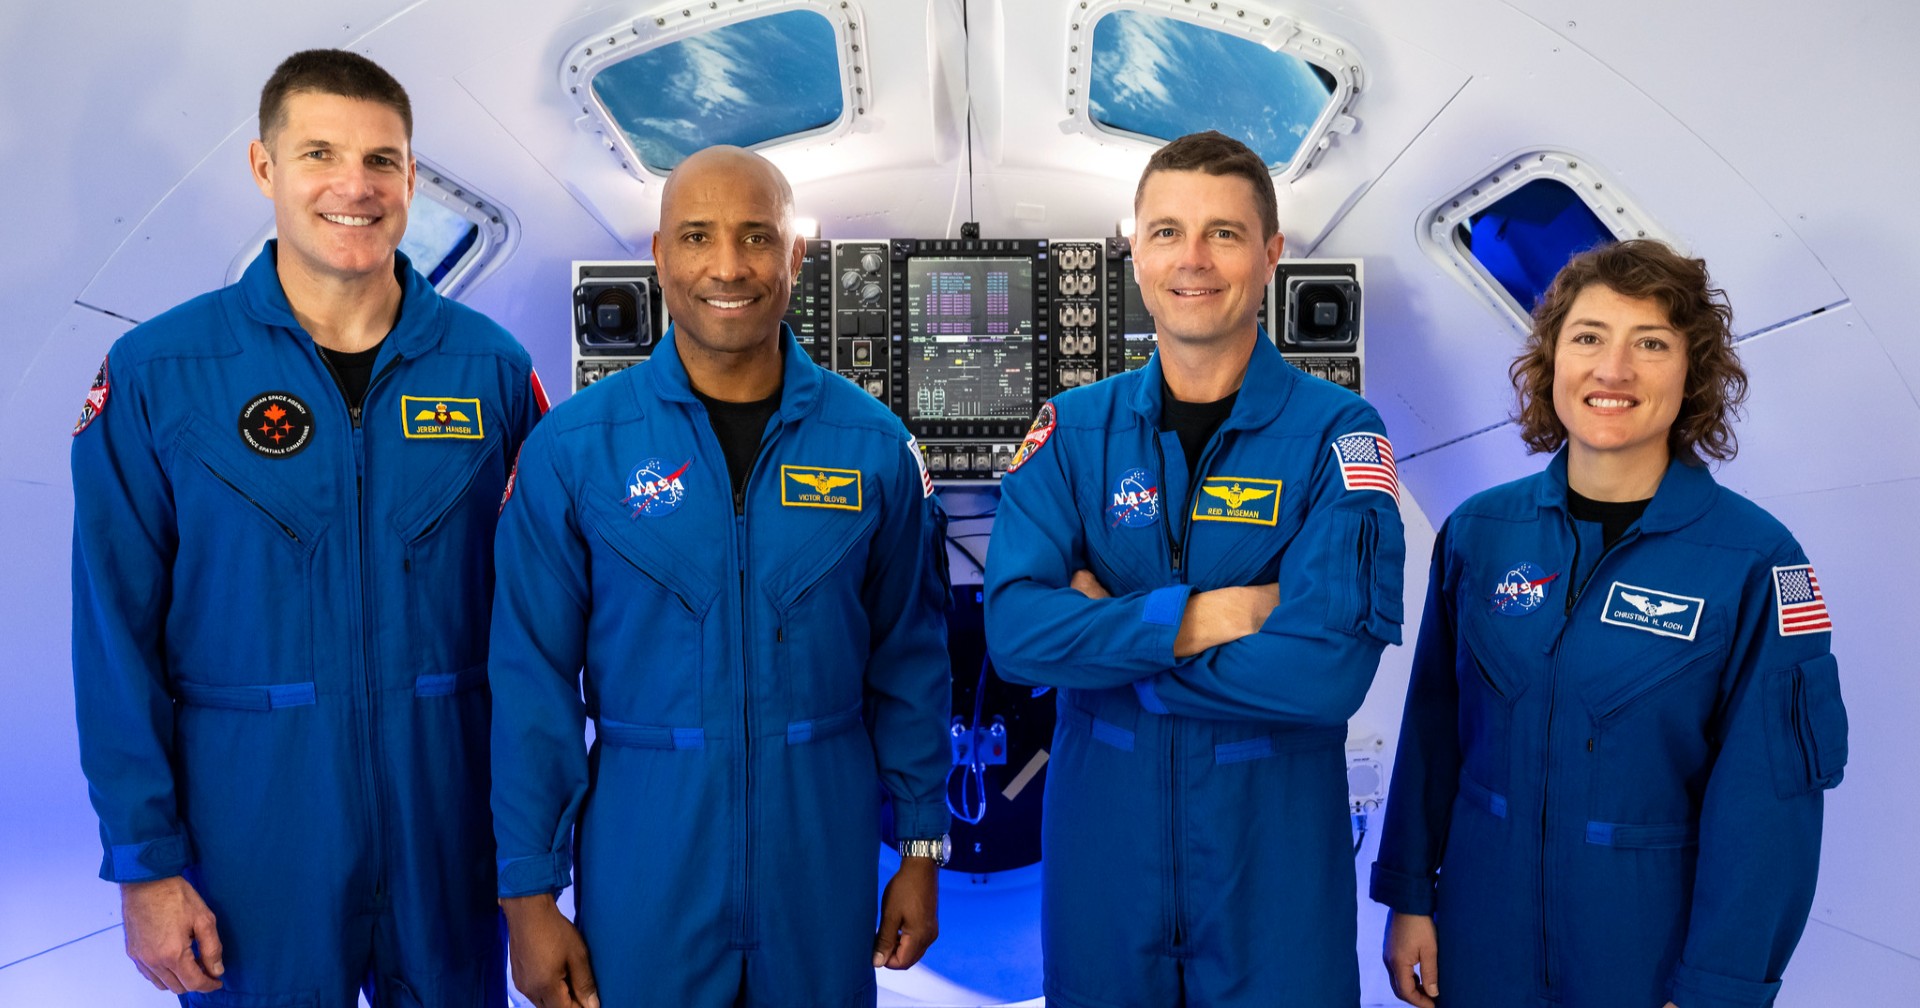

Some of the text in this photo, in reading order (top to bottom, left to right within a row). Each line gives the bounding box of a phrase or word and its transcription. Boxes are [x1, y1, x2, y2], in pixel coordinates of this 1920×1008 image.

[244, 397, 267, 418] CANADIAN
[287, 399, 306, 414] AGENCY
[445, 426, 471, 434] HANSEN
[244, 429, 259, 448] AGENCE
[259, 446, 285, 454] SPATIALE
[629, 477, 685, 498] NASA
[798, 494, 847, 503] VICTOR GLOVER
[1207, 508, 1260, 519] REID WISEMAN
[1495, 582, 1544, 598] NASA
[1613, 610, 1649, 624] CHRISTINA
[1662, 619, 1683, 631] KOCH
